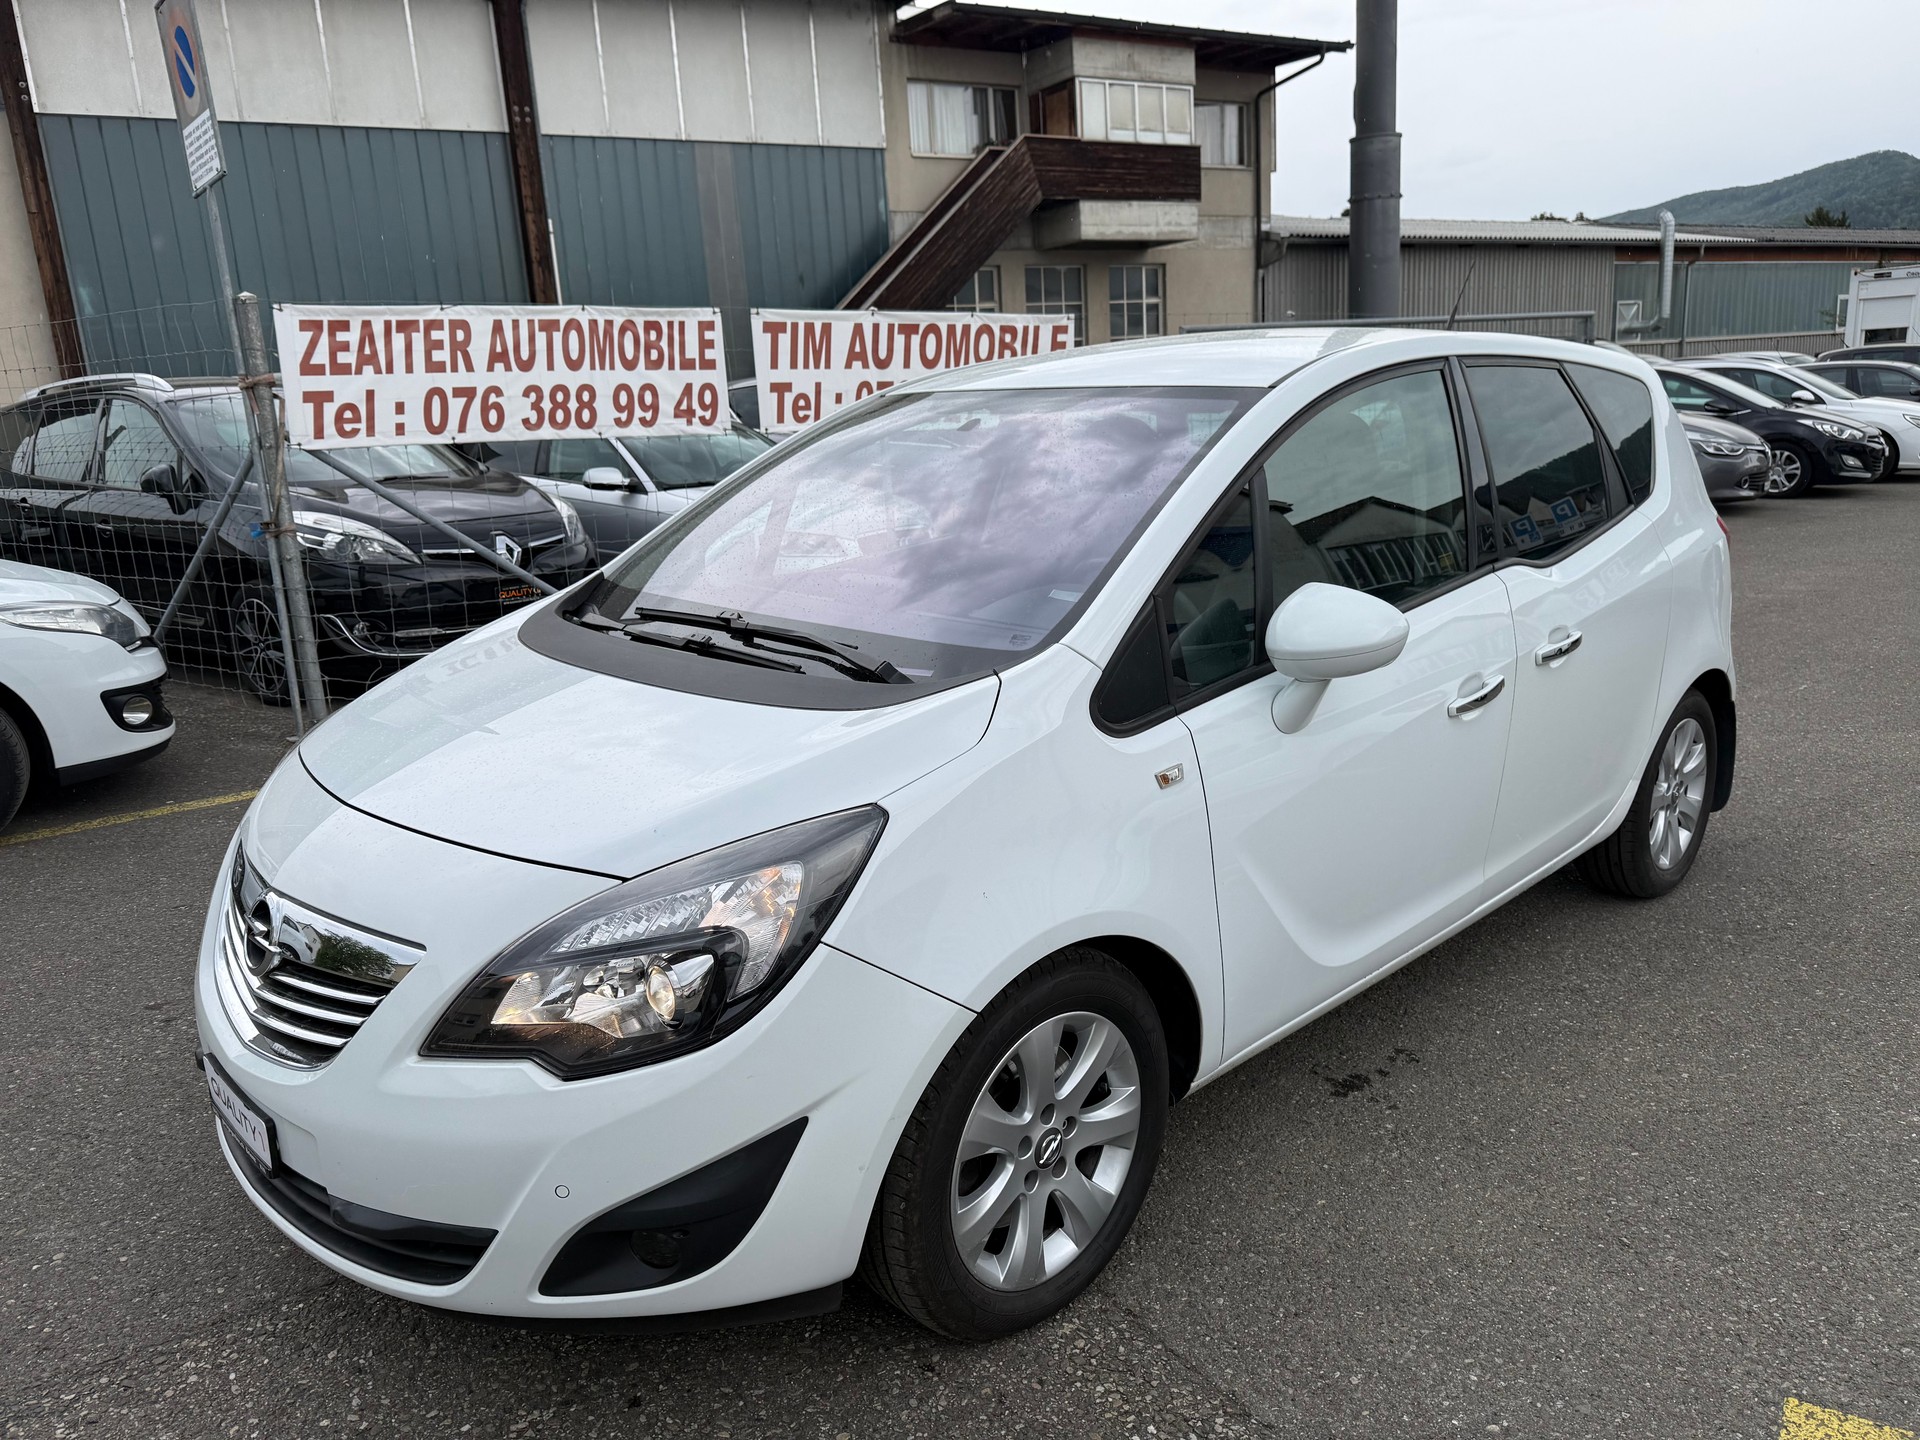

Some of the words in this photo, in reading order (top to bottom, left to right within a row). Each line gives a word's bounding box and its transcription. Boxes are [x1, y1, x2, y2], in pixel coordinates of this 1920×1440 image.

[298, 318, 475, 376] ZEAITER
[486, 318, 717, 373] AUTOMOBILE
[762, 321, 832, 370] TIM
[302, 388, 376, 441] Tel
[422, 384, 506, 435] 076
[521, 383, 598, 431] 388
[611, 382, 660, 428] 99
[673, 382, 719, 427] 49
[769, 381, 822, 424] Tel
[499, 587, 532, 599] QUALITY
[211, 1076, 256, 1141] QUALITY
